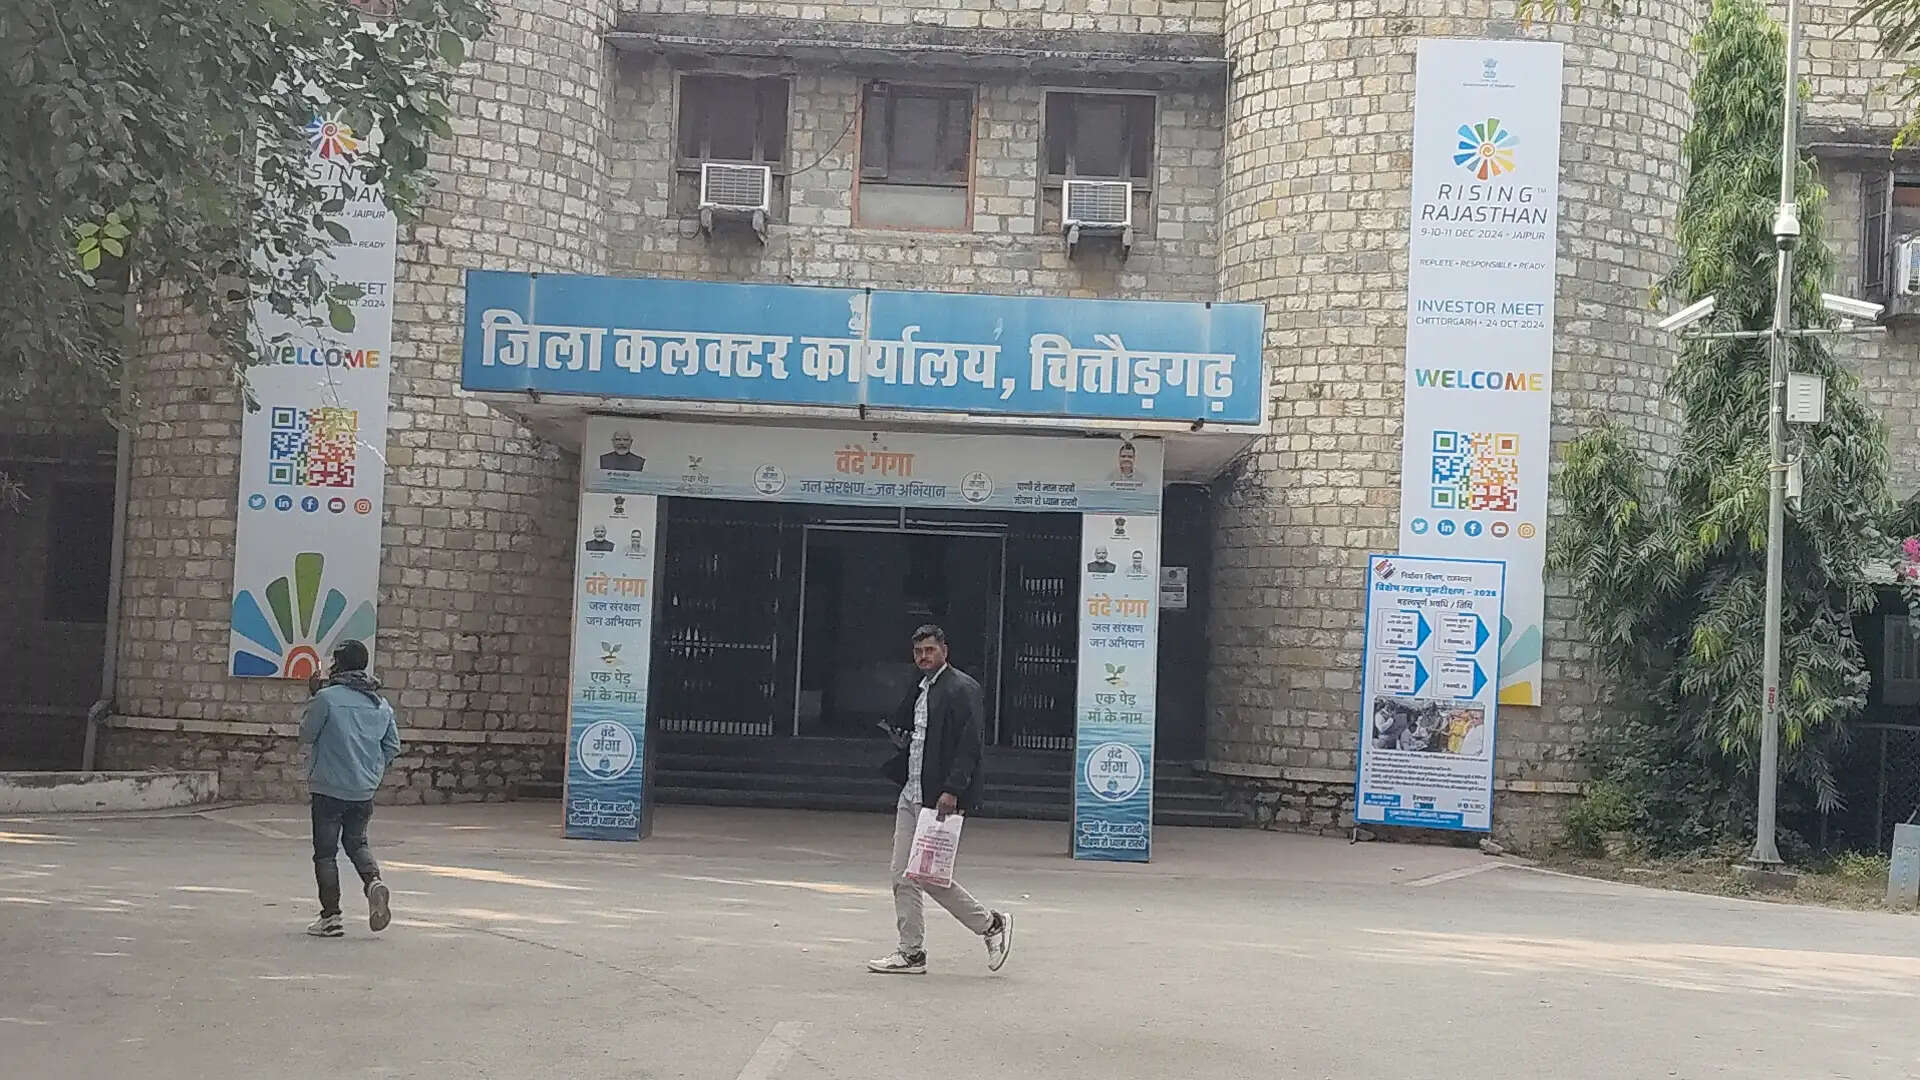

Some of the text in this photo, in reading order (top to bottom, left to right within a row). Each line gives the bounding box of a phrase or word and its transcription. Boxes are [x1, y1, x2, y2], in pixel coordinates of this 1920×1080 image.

[1438, 184, 1533, 203] RISING
[352, 210, 386, 218] JAIPUR
[1421, 204, 1548, 225] RAJASTHAN
[1455, 229, 1474, 239] DEC
[1478, 229, 1503, 239] 2024
[1512, 231, 1546, 241] JAIPUR
[358, 241, 386, 249] READY
[1419, 258, 1546, 271] REPLETE RESPONSIBLE READY
[361, 299, 386, 308] 2024
[1417, 300, 1545, 316] INVESTOR MEET
[1416, 316, 1545, 329] CHITTORGARH 24 OCT 2024
[482, 308, 1236, 412] जिला कलक्टर कार्यालय, चित्तौड़गढ़
[1415, 368, 1545, 391] WELCOME
[834, 444, 915, 477] वंदे गंगा
[800, 480, 822, 493] जल
[824, 478, 865, 496] संरक्षण
[875, 483, 896, 497] जन
[898, 481, 946, 498] अभियान
[585, 571, 648, 598] वंदे गंगा
[588, 601, 641, 613] जल संरक्षण
[1087, 593, 1149, 618] वंदे गंगा
[585, 614, 642, 628] जन अभियान
[1091, 621, 1145, 633] जल संरक्षण
[1089, 636, 1145, 649] जन अभियान
[590, 668, 633, 688] एक पेड़
[599, 686, 612, 702] के
[614, 691, 638, 704] नाम
[1095, 690, 1137, 709] एक पेड़
[1104, 709, 1117, 723] के
[1120, 712, 1143, 724] नाम
[600, 724, 616, 738] वंदे
[592, 738, 622, 753] गंगा
[1107, 746, 1123, 759] वंदे
[1100, 760, 1128, 774] गंगा
